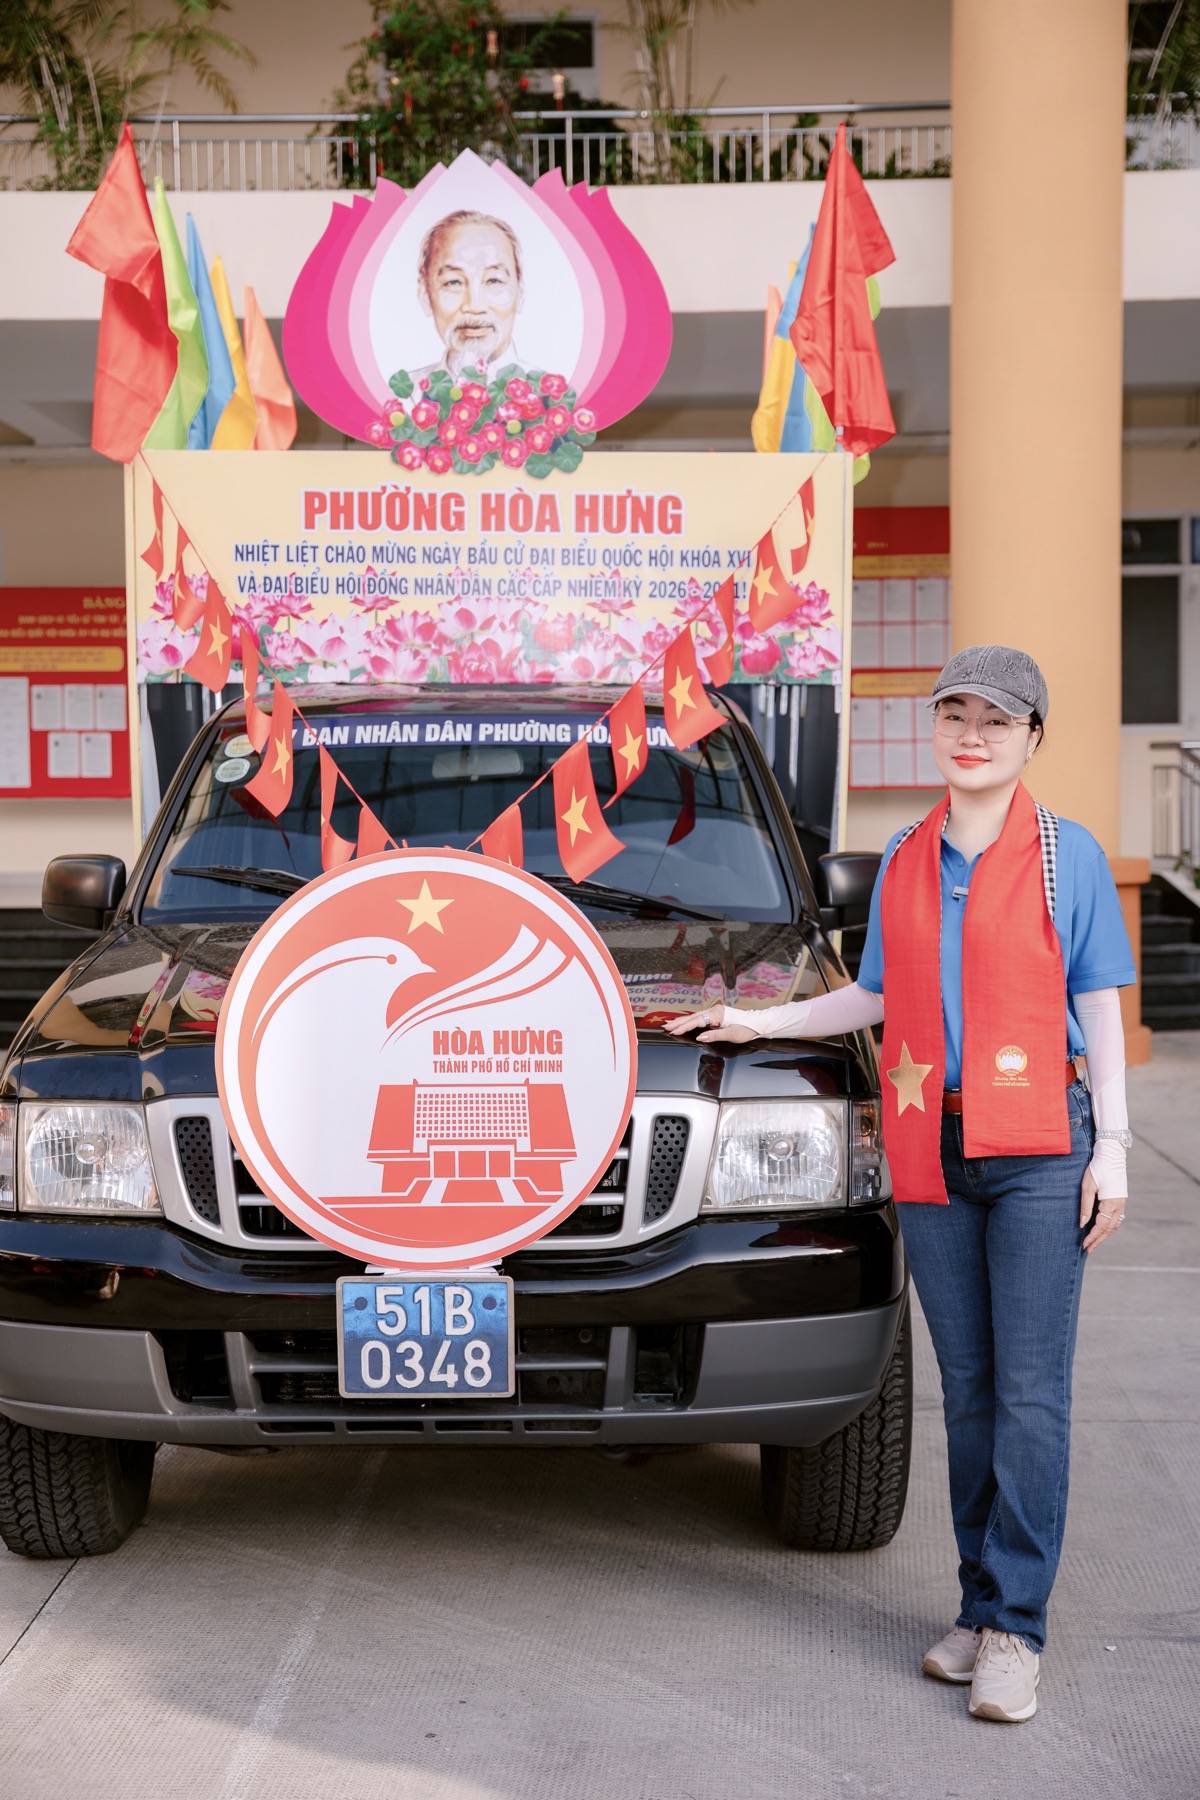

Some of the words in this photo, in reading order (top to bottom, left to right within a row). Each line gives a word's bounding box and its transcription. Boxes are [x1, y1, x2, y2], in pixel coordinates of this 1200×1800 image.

[304, 485, 465, 532] PHƯỜNG
[481, 486, 560, 533] HÒA
[575, 489, 683, 534] HƯNG
[234, 539, 280, 567] NHIỆT
[286, 540, 319, 567] LIỆT
[325, 540, 366, 563] CHÀO
[372, 540, 416, 564] MỪNG
[422, 541, 462, 564] NGÀY
[504, 540, 525, 565] CỬ
[529, 547, 555, 570] ĐẠI
[561, 538, 596, 566] BIỂU
[602, 541, 642, 570] QUỐC
[649, 544, 673, 571] HỘI
[680, 544, 721, 568] KHÓA
[727, 549, 751, 568] XVI
[237, 570, 257, 593] VÀ
[263, 576, 288, 598] ĐẠI
[294, 567, 329, 594] BIỂU
[336, 572, 361, 599] HỘI
[367, 568, 408, 595] ĐỒNG
[414, 573, 455, 595] NHÂN
[461, 573, 492, 596] DÂN
[497, 574, 527, 597] CÁC
[533, 571, 562, 597] CẤP
[567, 575, 617, 601] NHIỆM
[623, 575, 643, 598] KỲ
[648, 581, 687, 598] 2026
[703, 581, 746, 599] 201!
[302, 726, 350, 747] BAN
[355, 721, 419, 744] NHÂN
[425, 720, 472, 742] DÂN
[479, 719, 571, 742] PHƯỜNG
[577, 722, 611, 744] HÒ
[432, 1026, 485, 1055] HÒA
[493, 1026, 563, 1055] HƯNG
[433, 1058, 468, 1073] THÀNH
[471, 1057, 493, 1073] PHỐ
[496, 1057, 510, 1073] HỒ
[513, 1057, 531, 1073] CHÍ
[534, 1060, 563, 1073] MINH
[376, 1285, 475, 1336] 51B
[361, 1340, 492, 1389] 0348
